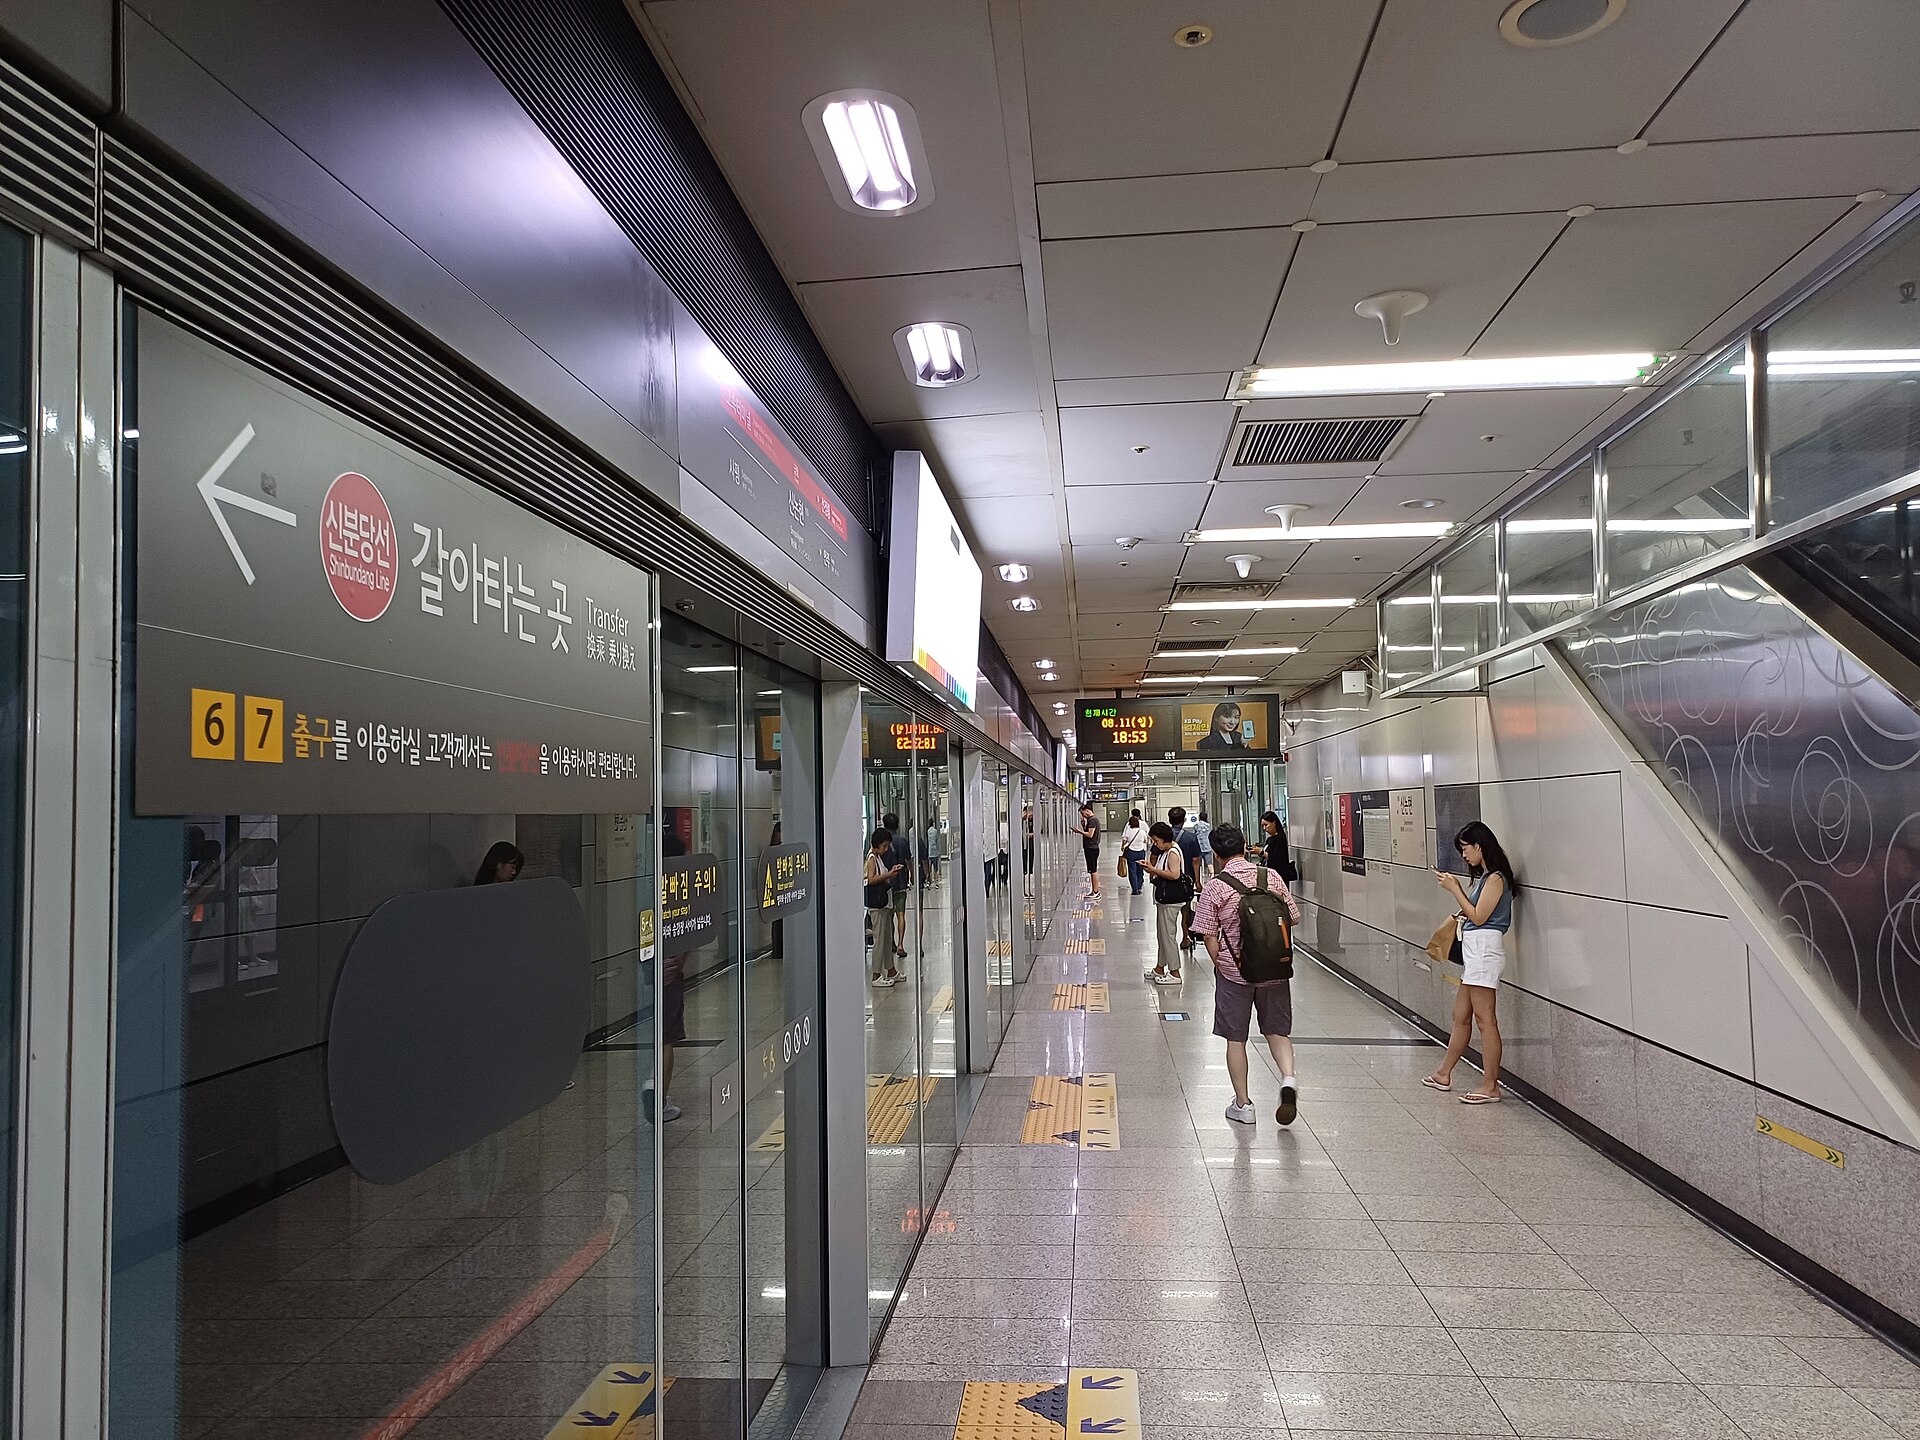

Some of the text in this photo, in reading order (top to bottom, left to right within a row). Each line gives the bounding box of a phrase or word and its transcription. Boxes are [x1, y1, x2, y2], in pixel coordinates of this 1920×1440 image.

[326, 500, 390, 569] 신분당선
[329, 554, 390, 592] Shinbundang Line
[411, 522, 573, 654] 갈아타는 곳
[585, 597, 629, 637] Transfer
[204, 702, 225, 746] 6
[256, 707, 273, 749] 7
[291, 713, 351, 761] 출구를
[356, 722, 421, 766] 이용하실
[425, 732, 493, 770] 고객께서는
[552, 745, 597, 778] 이용하시면
[598, 751, 638, 779] 편리합니다.
[1112, 731, 1147, 743] 18:53
[694, 866, 716, 897] 주의!
[661, 908, 671, 920] atch
